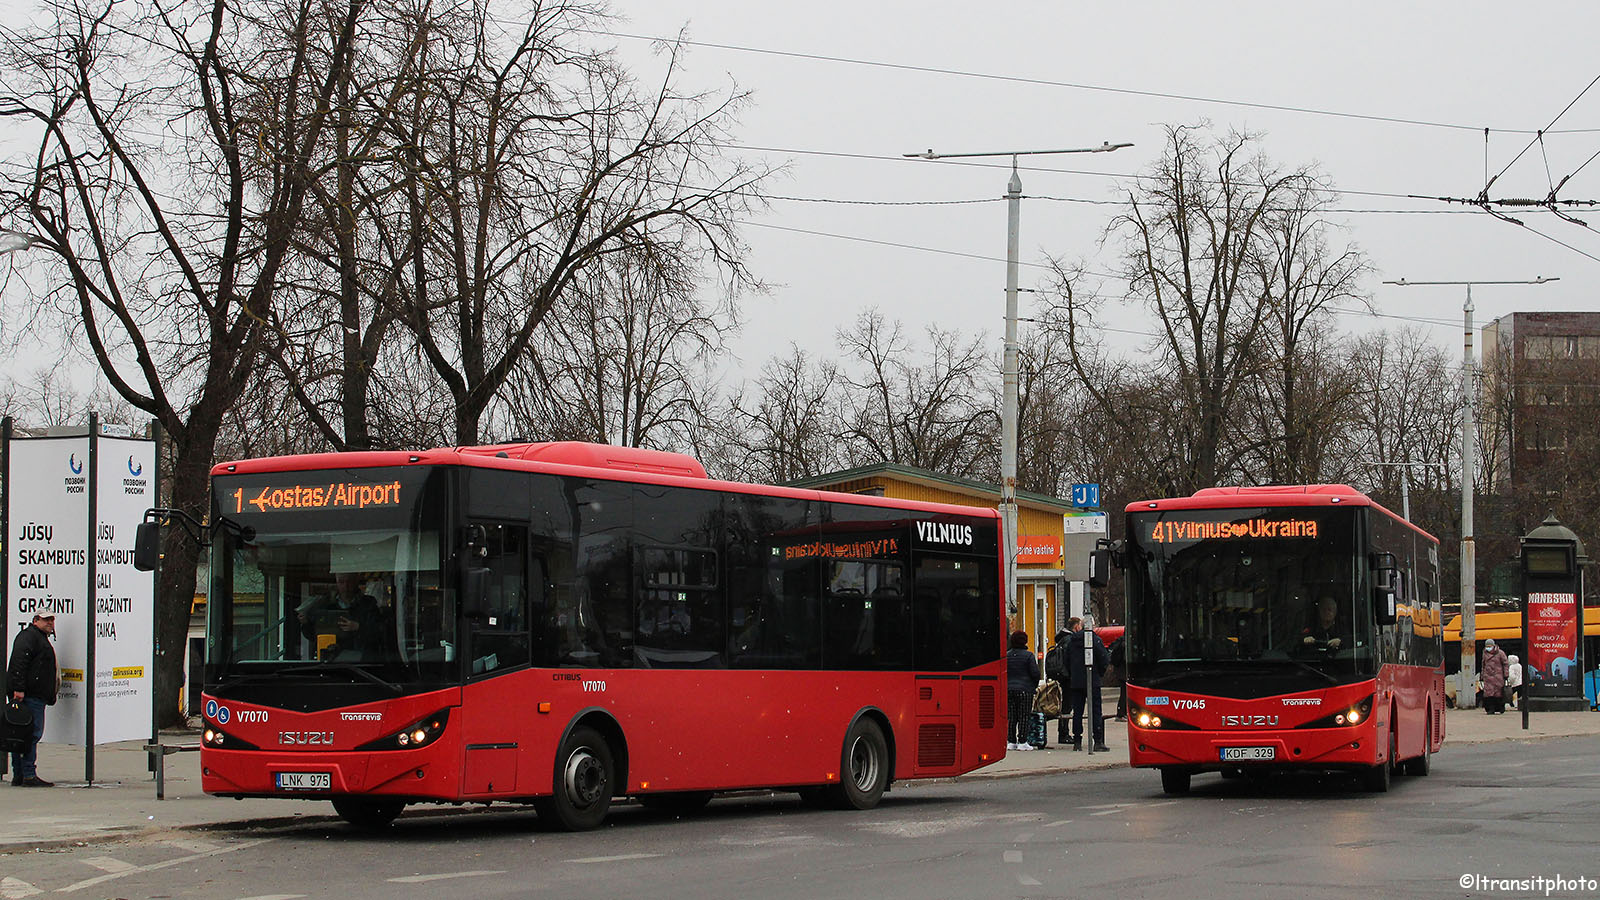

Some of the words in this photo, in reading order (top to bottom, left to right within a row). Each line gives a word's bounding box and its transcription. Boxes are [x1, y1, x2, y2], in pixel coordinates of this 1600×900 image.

[67, 486, 85, 494] РОССИИ
[123, 479, 147, 487] ПОЗВОНИ
[125, 487, 145, 495] РОССИИ
[233, 487, 243, 514] 1
[19, 521, 53, 544] JŪSŲ
[916, 520, 973, 546] VILNIUS
[1152, 521, 1174, 543] 41
[19, 549, 85, 565] SKAMBUTIS
[97, 549, 135, 565] SKAMBUT
[18, 573, 49, 589] GALI
[97, 573, 111, 589] GALI
[97, 594, 132, 617] GRĄŽINTI
[96, 622, 117, 641] TAIKĄ
[552, 673, 581, 681] CITIBUS
[582, 681, 606, 692] V7070
[1172, 699, 1206, 710] V7045
[236, 711, 269, 723] V7070
[1221, 715, 1279, 726] ISUZU
[278, 731, 334, 745] ISUZU
[1226, 748, 1248, 758] KDF
[1254, 748, 1273, 758] 329
[282, 774, 303, 786] LNK
[310, 774, 329, 787] 975
